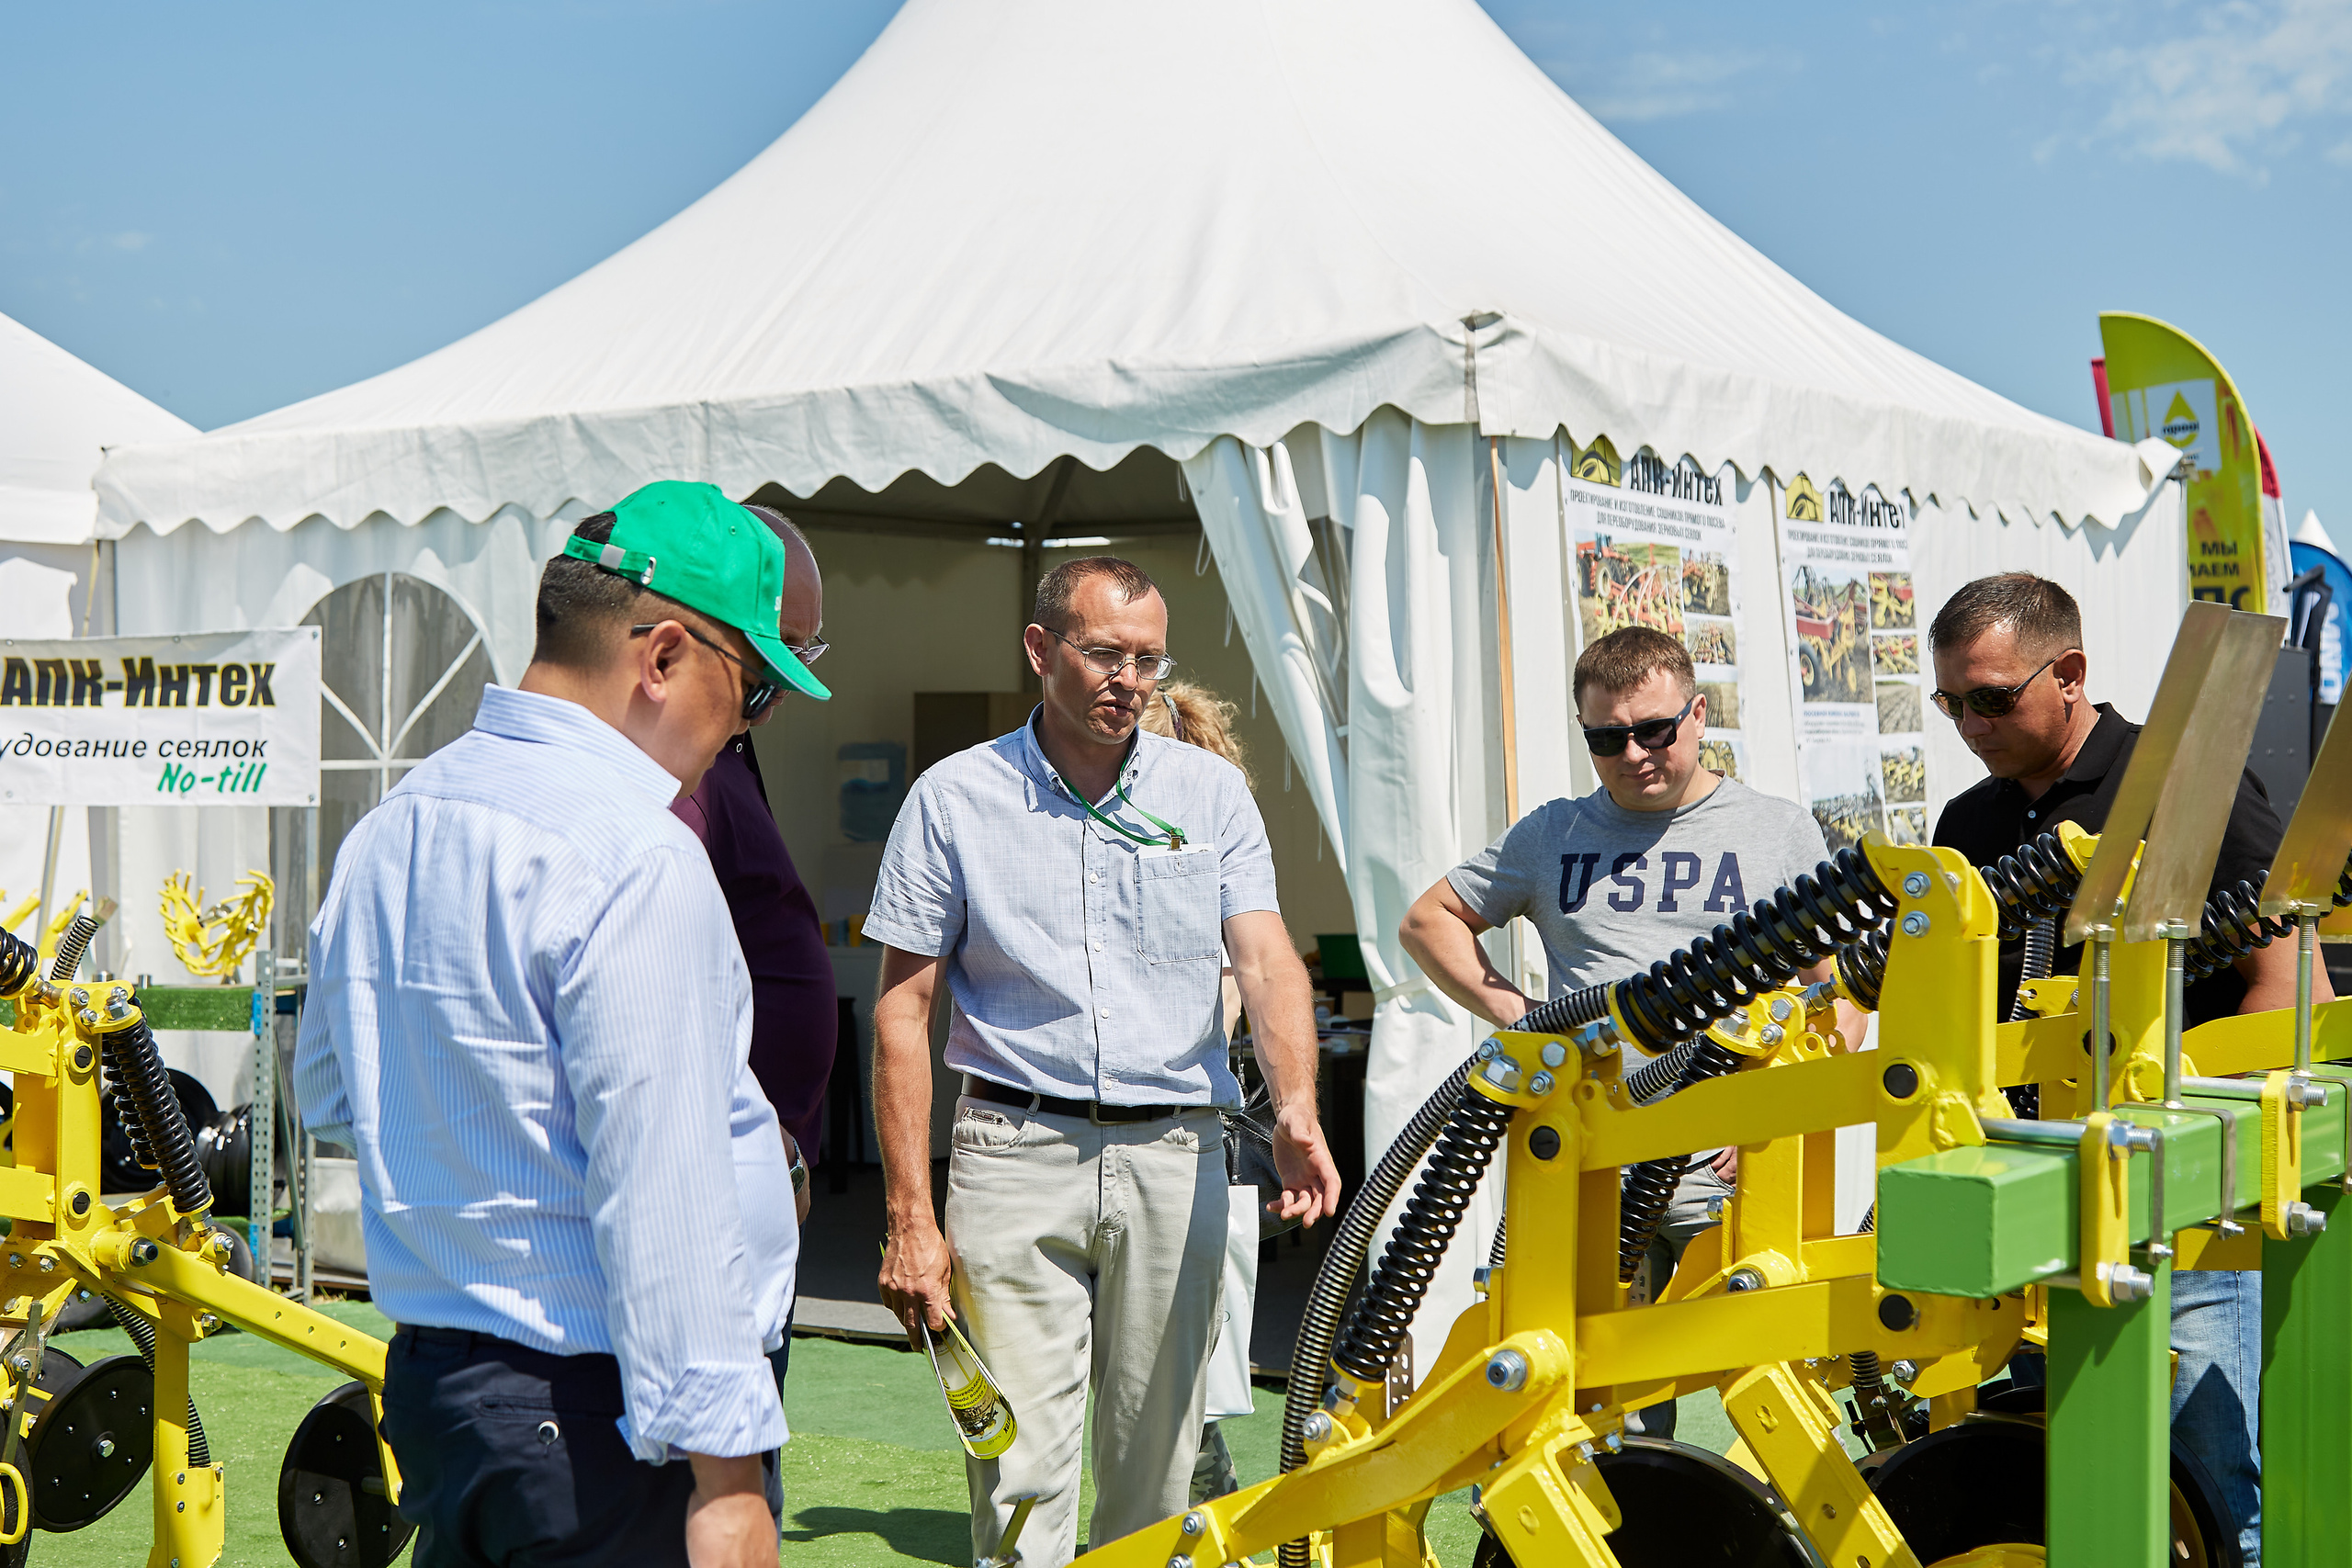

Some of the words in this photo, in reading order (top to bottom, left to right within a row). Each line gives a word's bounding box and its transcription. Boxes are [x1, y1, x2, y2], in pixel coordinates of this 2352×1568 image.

[2201, 541, 2238, 557] МЫ
[0, 656, 276, 707] АПК-Интех
[0, 732, 147, 761] удование
[158, 739, 267, 758] сеялок
[157, 761, 266, 793] No-till
[1559, 852, 1750, 915] USPA
